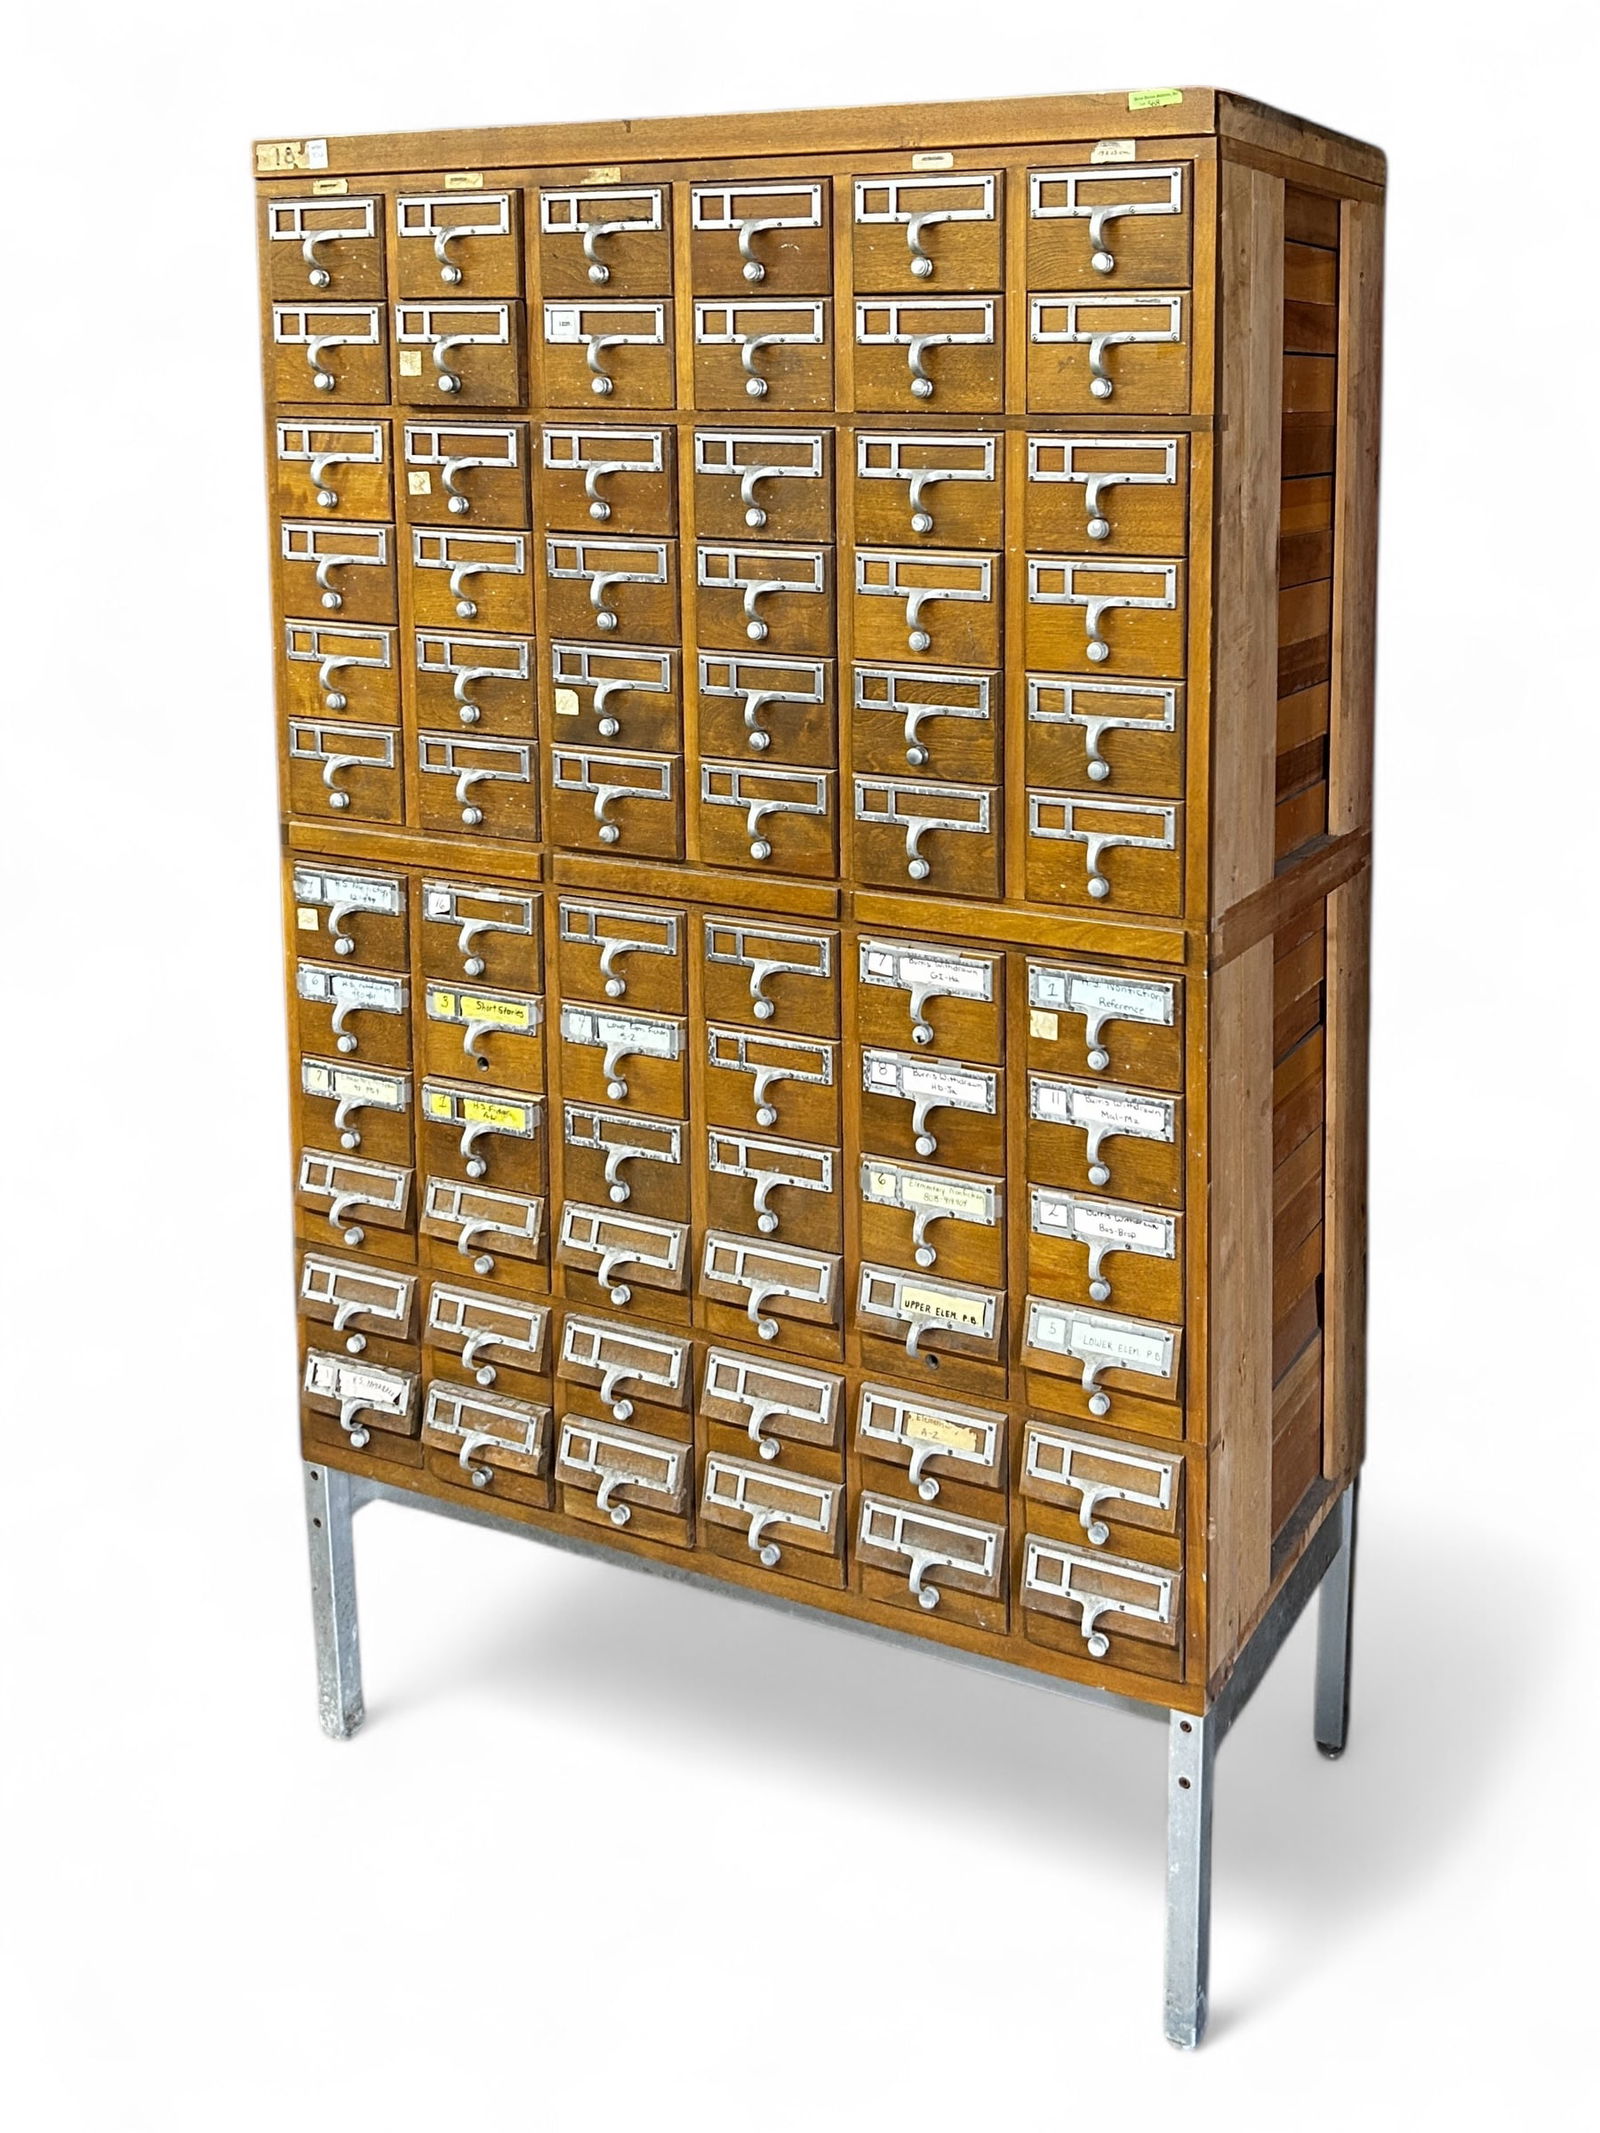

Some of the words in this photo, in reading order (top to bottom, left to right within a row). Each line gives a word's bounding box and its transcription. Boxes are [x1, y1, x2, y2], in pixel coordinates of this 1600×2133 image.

[275, 147, 295, 166] 18
[441, 996, 449, 1008] 3
[476, 1000, 497, 1012] Short
[498, 1005, 524, 1018] Stories
[1099, 997, 1144, 1015] Reference
[878, 1172, 886, 1186] 6
[904, 1299, 931, 1314] UPPER
[1048, 1322, 1057, 1335] 5
[1083, 1335, 1113, 1350] LOWER
